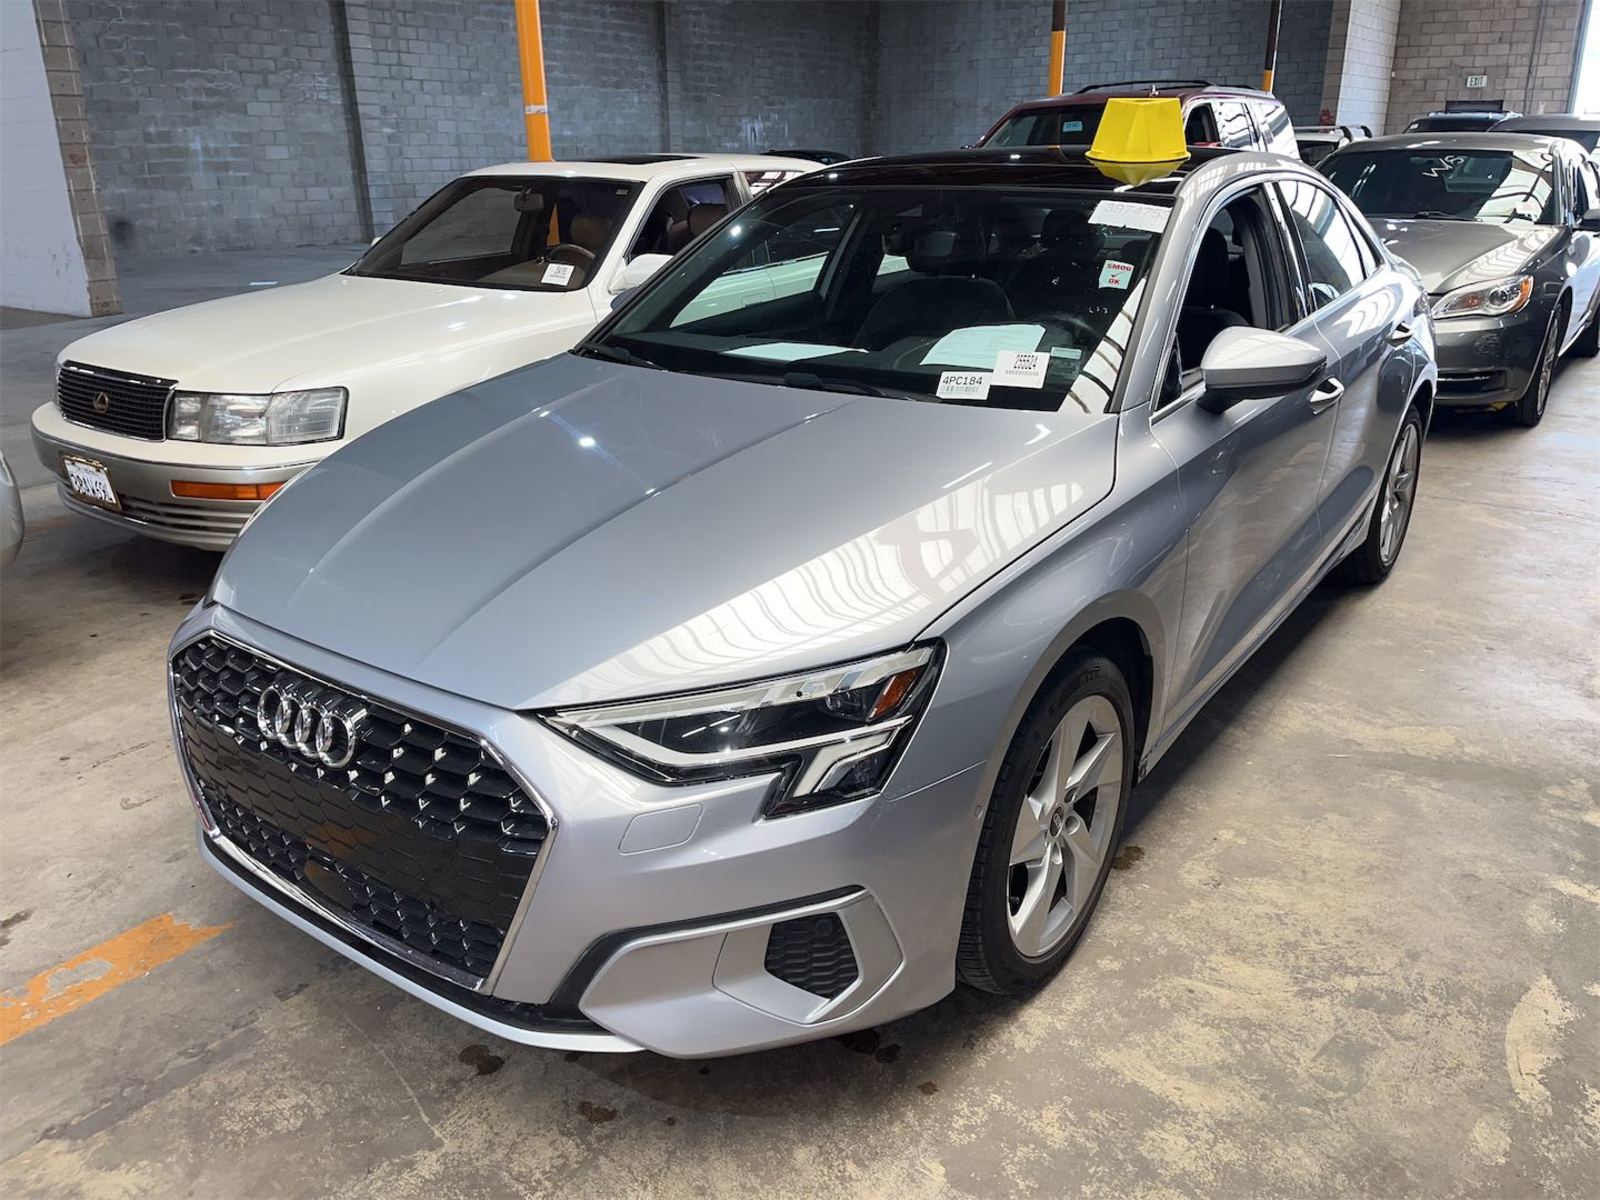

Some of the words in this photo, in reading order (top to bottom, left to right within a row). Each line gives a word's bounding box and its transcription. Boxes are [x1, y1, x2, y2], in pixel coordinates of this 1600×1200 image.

[1106, 263, 1132, 272] SMOG
[1108, 278, 1121, 286] OK
[942, 376, 983, 386] 4PC184
